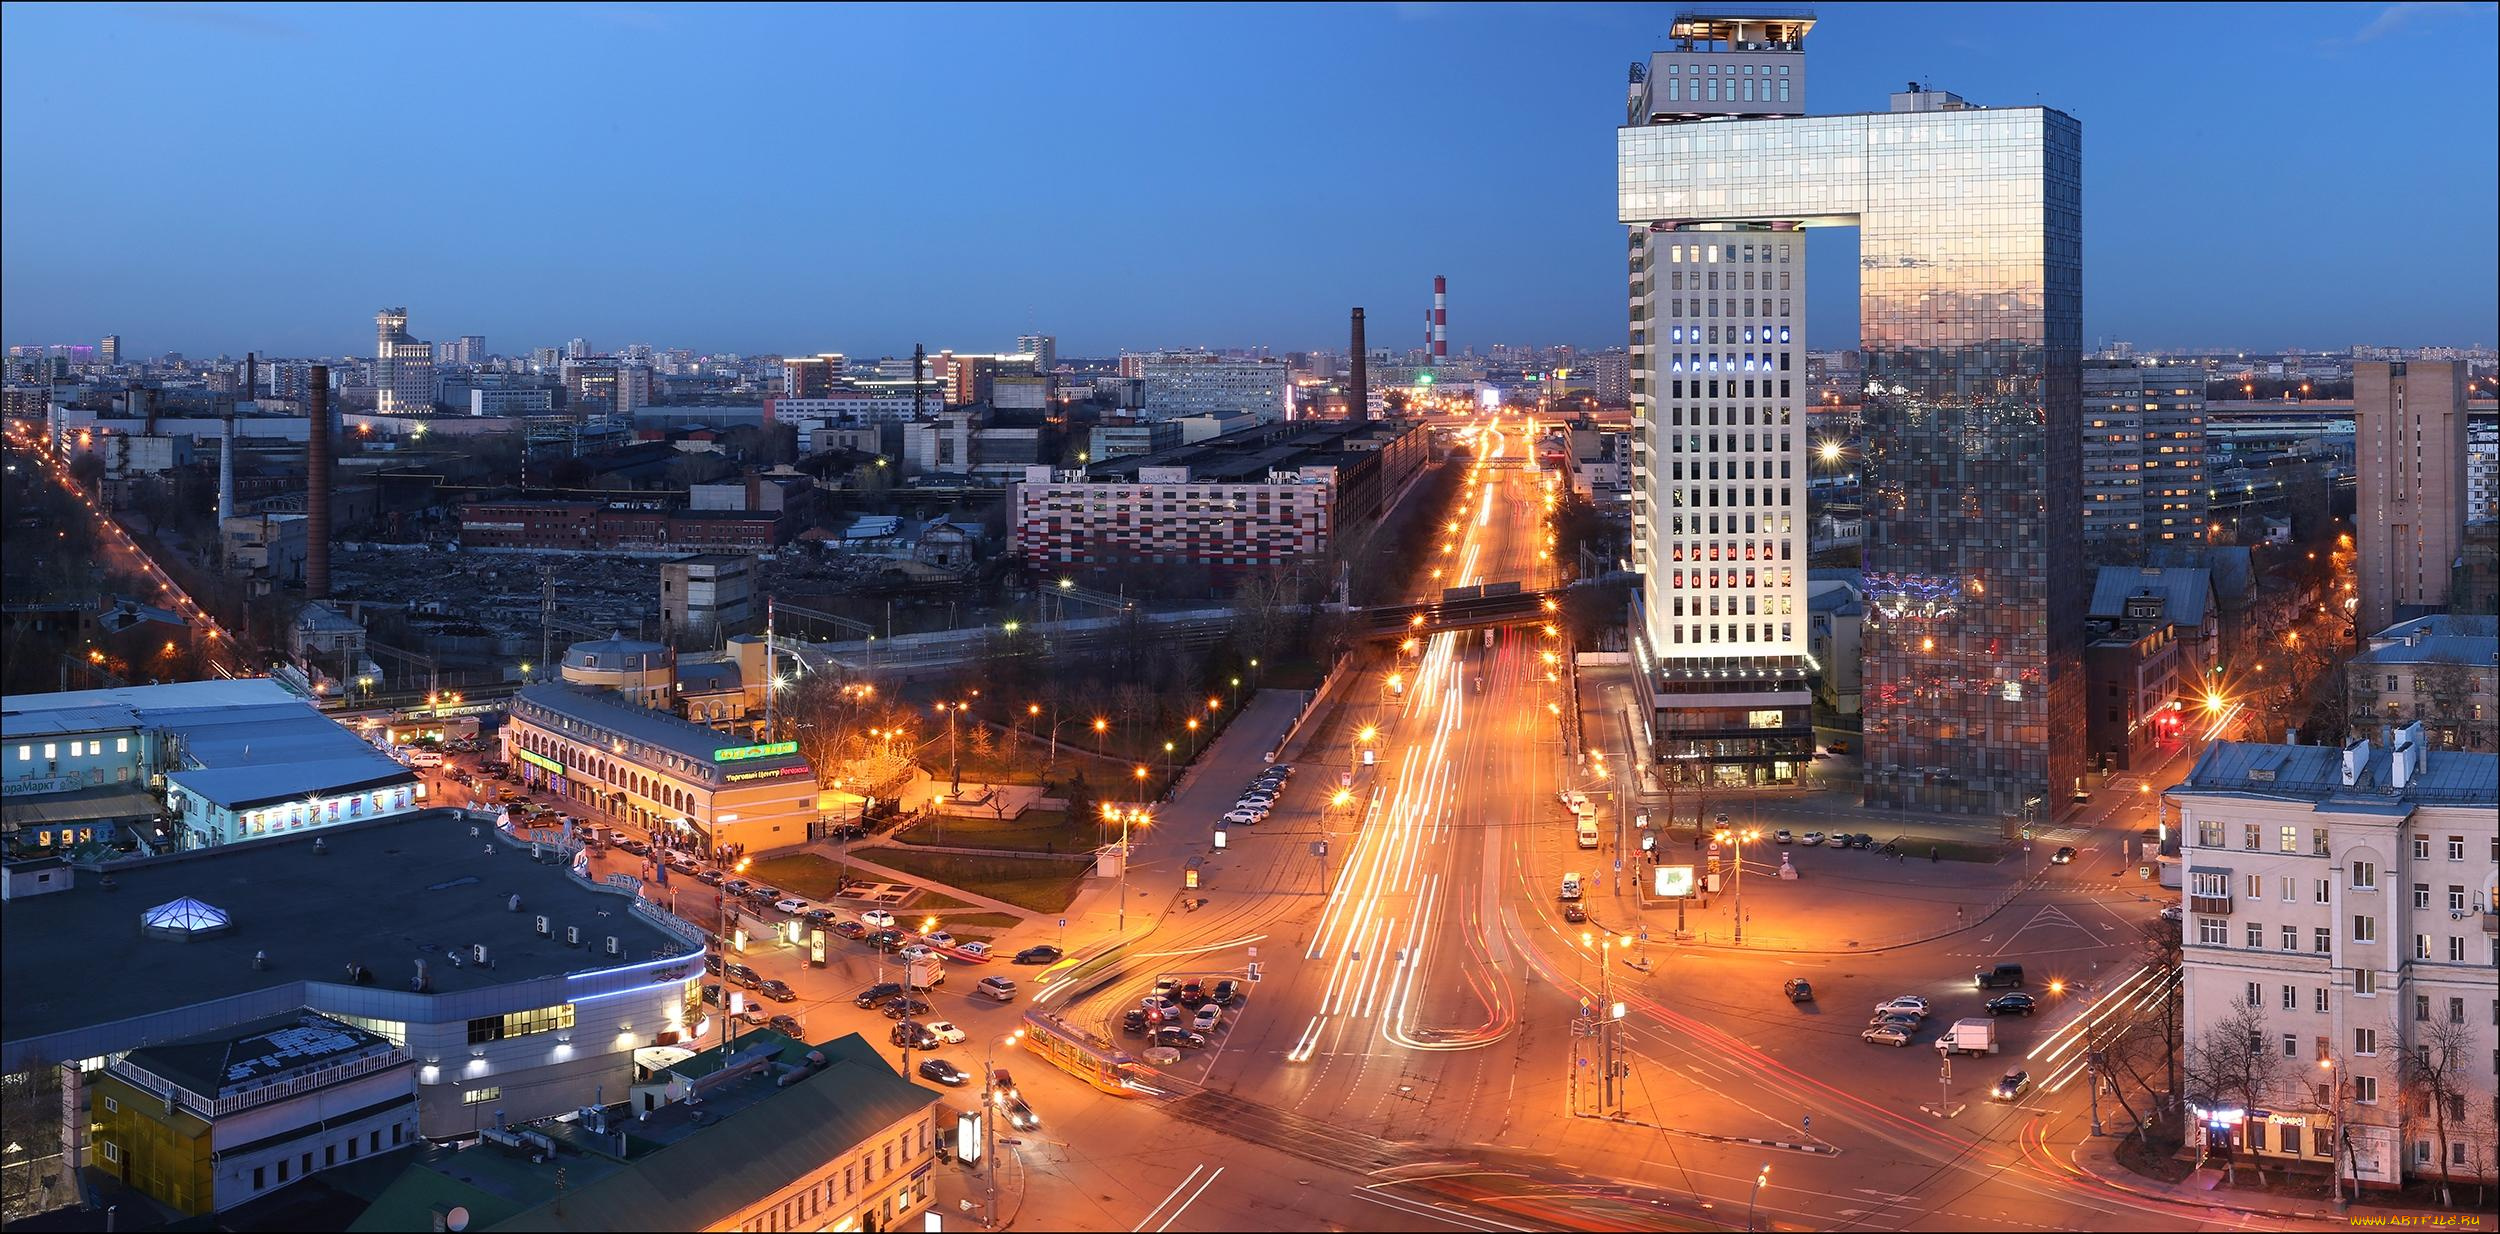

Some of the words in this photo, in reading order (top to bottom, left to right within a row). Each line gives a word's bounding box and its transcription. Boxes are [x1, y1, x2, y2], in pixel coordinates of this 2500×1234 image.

[1673, 360, 1772, 372] АРЕНДА
[1673, 547, 1772, 560] АРЕНДА
[2, 781, 55, 794] ораМаркт
